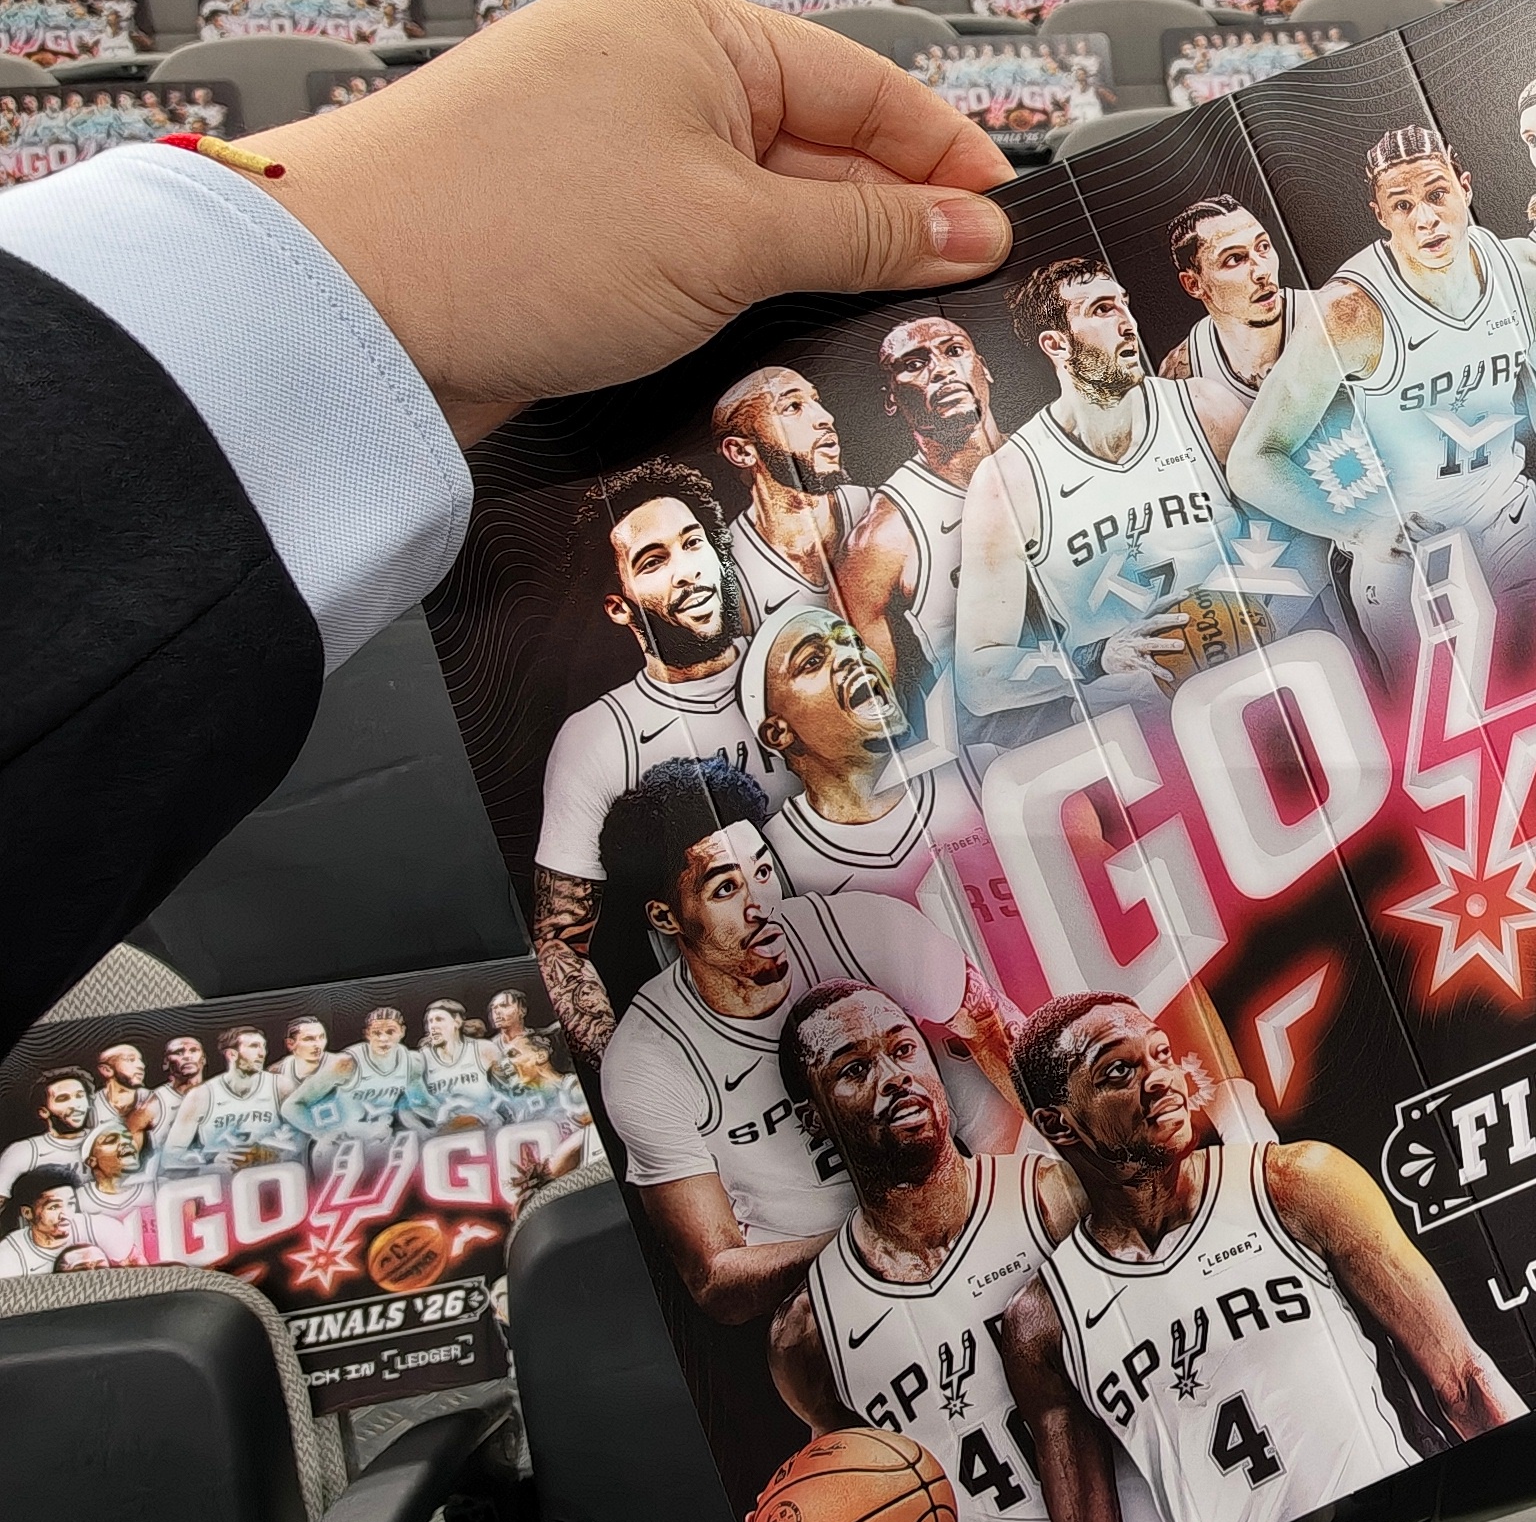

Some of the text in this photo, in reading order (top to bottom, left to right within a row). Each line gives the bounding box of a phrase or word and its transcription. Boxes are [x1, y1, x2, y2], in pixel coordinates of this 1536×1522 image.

[1400, 348, 1527, 413] SPURS
[1066, 489, 1214, 568] SPURS
[980, 628, 1392, 1020] GO
[157, 1160, 309, 1266] GO
[977, 1257, 1024, 1291] LEDGER
[1205, 1236, 1255, 1270] LEDGER
[287, 1289, 467, 1346] FINALS '26
[1096, 1275, 1312, 1428] SPURS
[342, 1360, 376, 1380] IN
[394, 1343, 464, 1371] LEDGER
[864, 1311, 1008, 1433] SPU
[1205, 1390, 1287, 1491] 4
